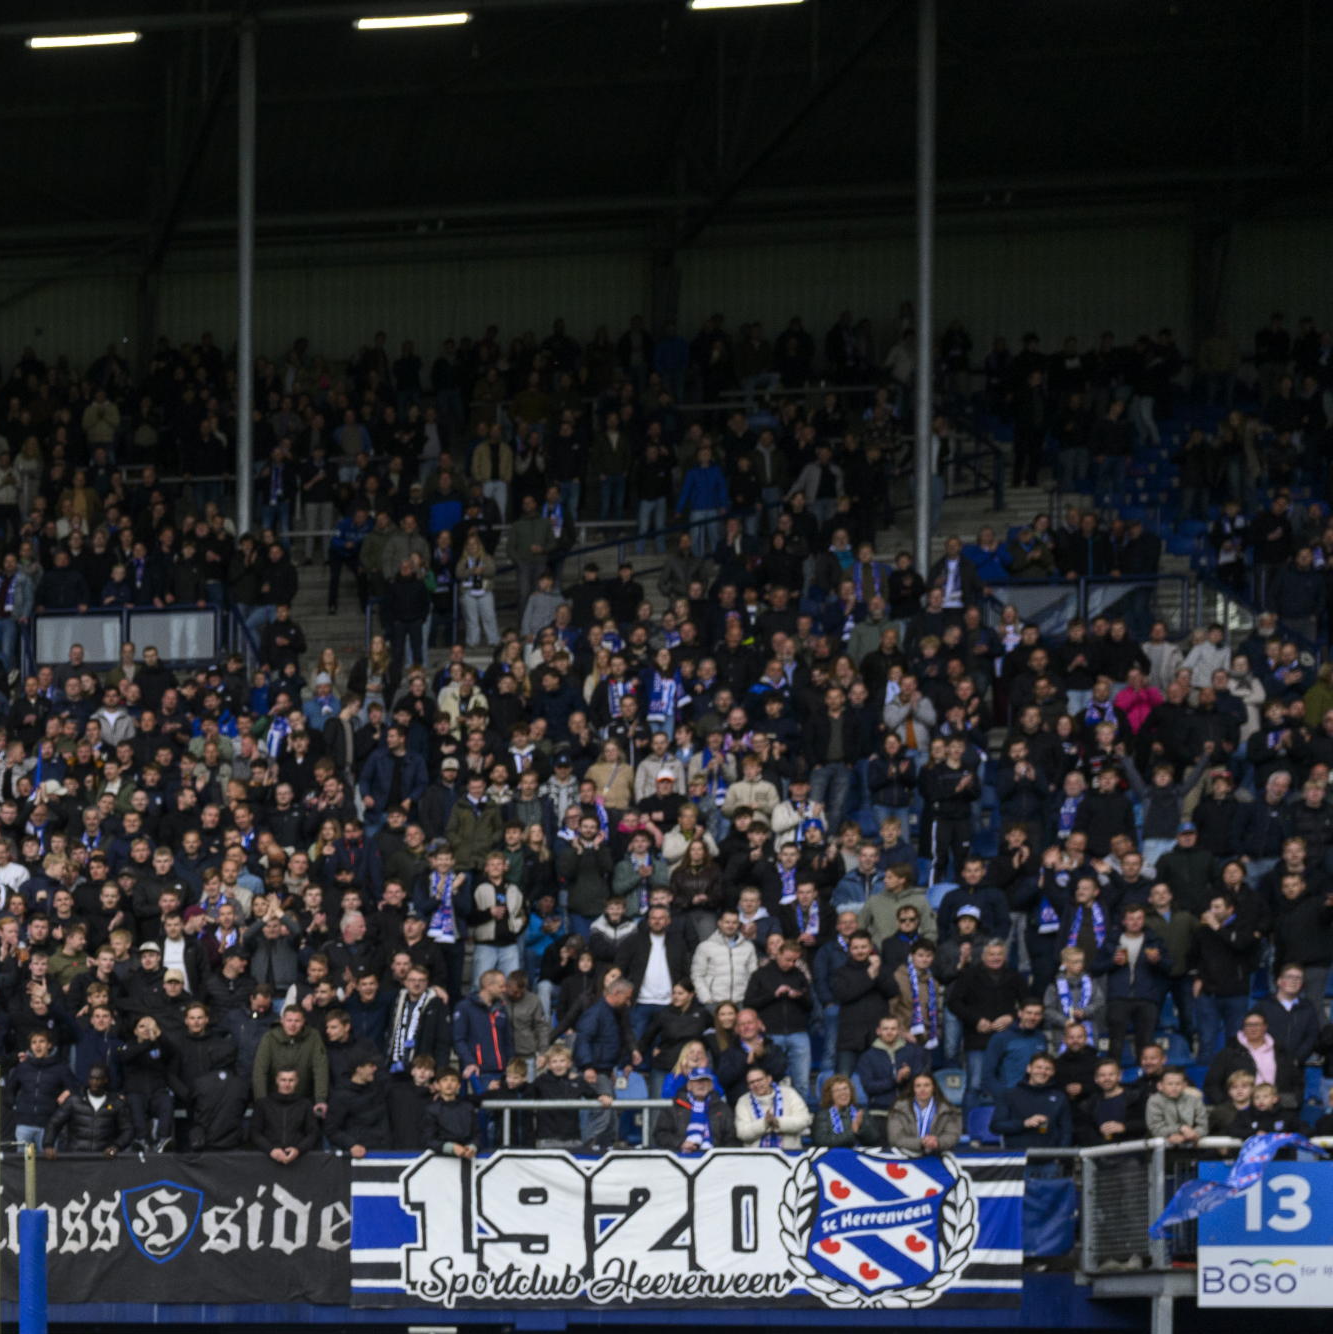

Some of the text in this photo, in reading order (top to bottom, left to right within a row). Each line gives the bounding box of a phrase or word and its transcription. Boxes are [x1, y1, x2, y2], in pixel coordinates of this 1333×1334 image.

[200, 1183, 351, 1255] side
[403, 1150, 793, 1295] 1920
[841, 1203, 932, 1229] Heerenveen
[1233, 1173, 1312, 1232] 13
[420, 1256, 796, 1304] Sportclub Heerenveen
